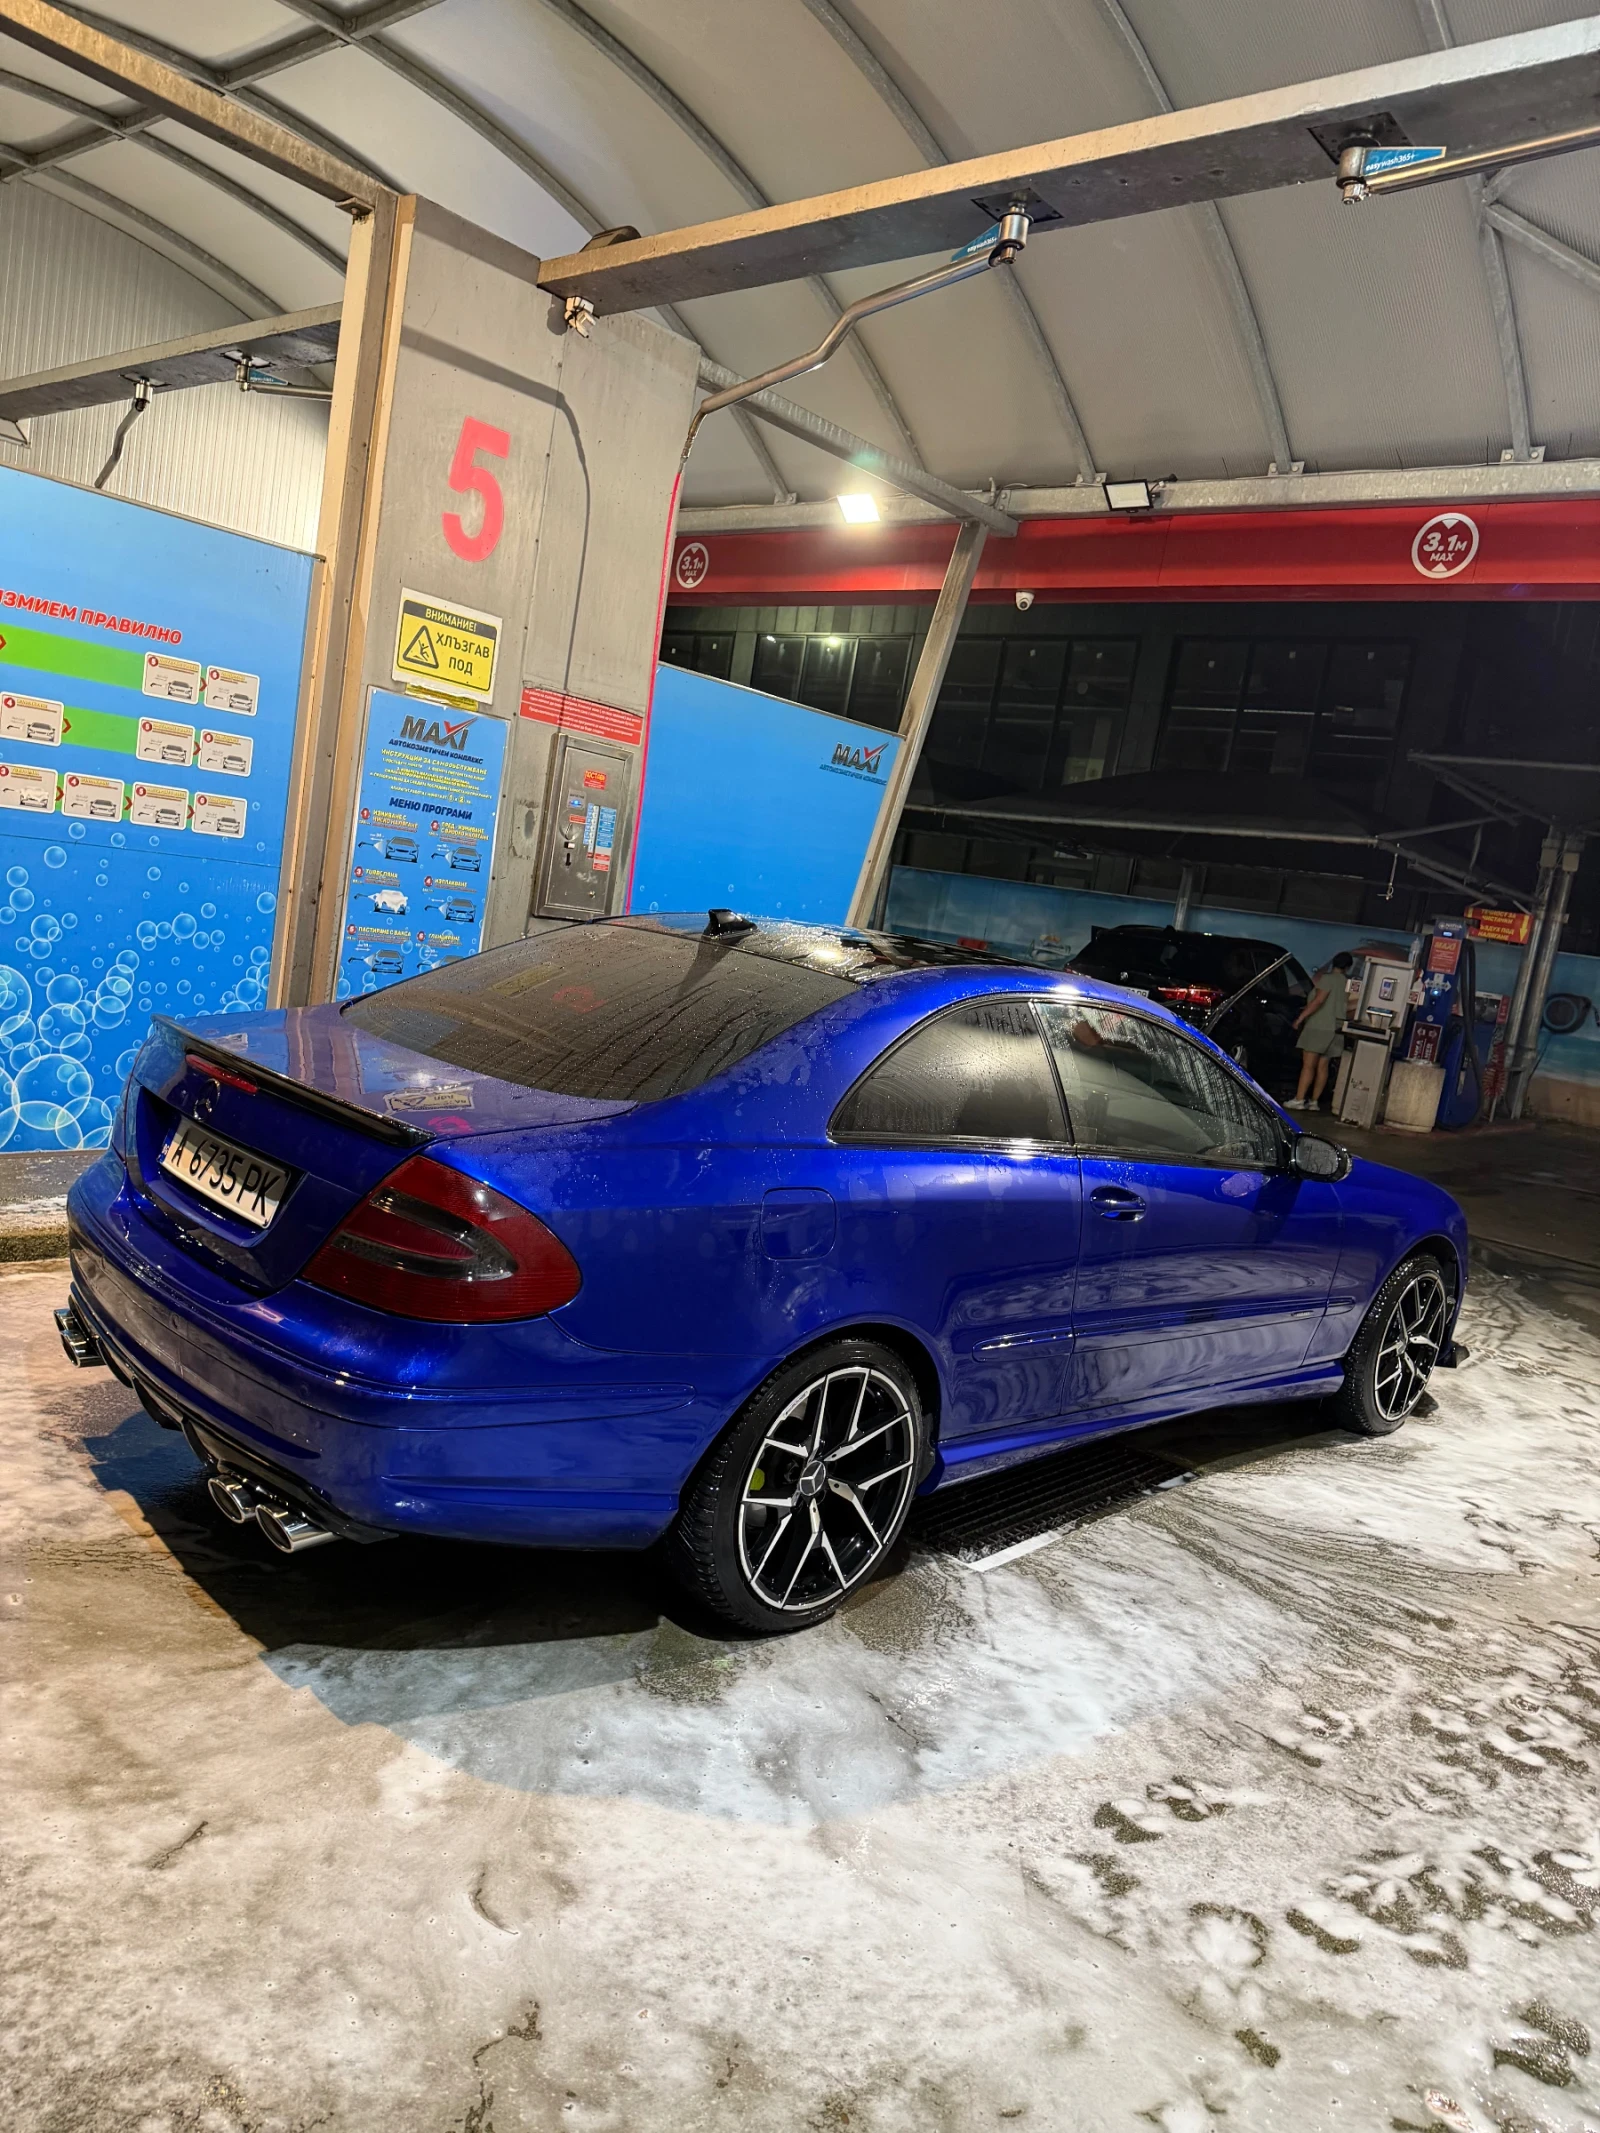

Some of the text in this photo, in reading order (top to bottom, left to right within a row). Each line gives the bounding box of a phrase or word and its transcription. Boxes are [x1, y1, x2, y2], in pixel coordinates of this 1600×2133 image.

[442, 416, 510, 562] 5
[80, 608, 182, 645] ПРАВИЛНО
[425, 608, 477, 632] ВНИМАНИЕ!
[436, 632, 490, 658] ХЛЪЗГАВ
[448, 656, 473, 676] ПОД
[400, 715, 478, 751] MAXI
[831, 742, 889, 775] MAXI
[389, 797, 473, 820] МЕНЮ ПРОГРАМИ
[190, 1140, 243, 1195] 6735
